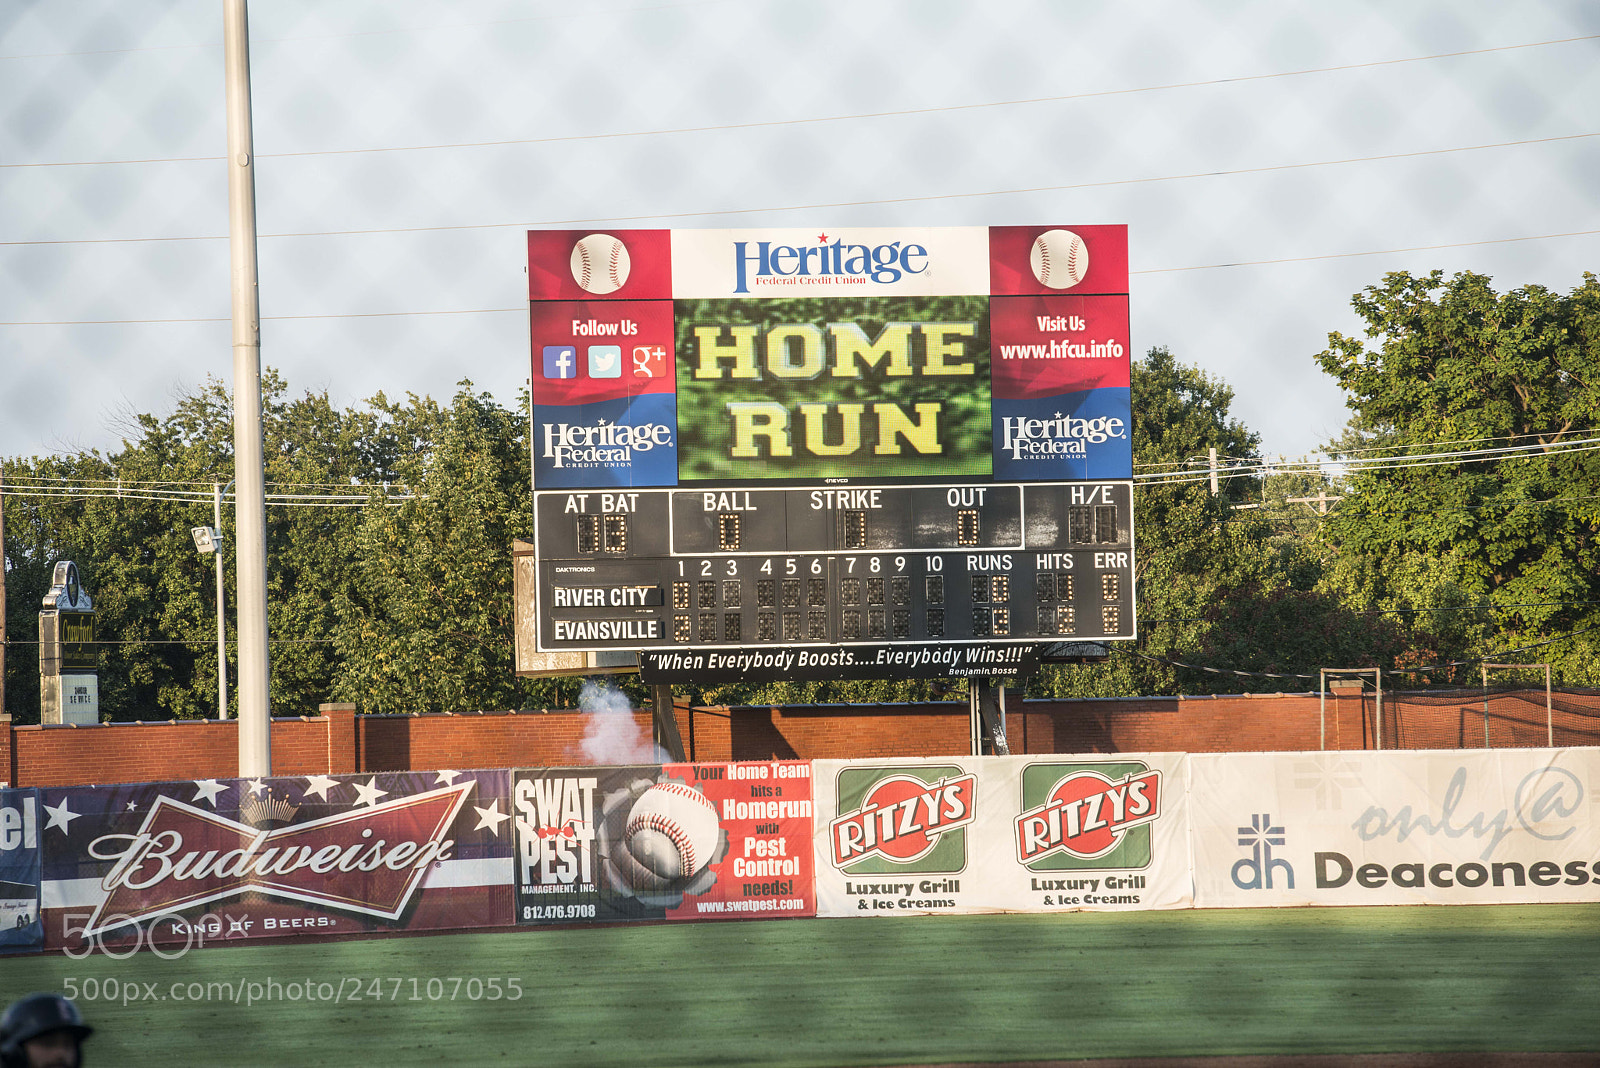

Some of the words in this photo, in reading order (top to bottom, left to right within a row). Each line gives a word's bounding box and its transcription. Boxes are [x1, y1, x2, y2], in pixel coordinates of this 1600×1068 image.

[733, 238, 929, 293] Heritage
[756, 276, 797, 285] Federal
[799, 276, 832, 285] Credit
[835, 275, 867, 284] Union
[572, 320, 619, 336] Follow
[621, 320, 638, 336] Us
[1037, 316, 1066, 332] Visit
[1069, 316, 1085, 331] Us
[693, 322, 977, 380] HOME
[1000, 339, 1123, 359] www.hfcu.info
[542, 421, 672, 458] Heritage
[728, 402, 943, 457] RUN
[1002, 413, 1125, 450] Heritage
[553, 445, 631, 468] Federal
[1012, 438, 1086, 460] Federal
[565, 494, 588, 513] AT
[601, 493, 639, 513] BAT
[703, 491, 757, 511] BALL
[810, 489, 883, 510] STRIKE
[946, 487, 987, 507] OUT
[1070, 485, 1114, 505] H/E
[678, 560, 684, 577] 1
[700, 560, 712, 576] 2
[726, 559, 738, 576] 3
[760, 559, 772, 575] 4
[785, 558, 797, 575] 5
[810, 558, 822, 574] 6
[845, 557, 856, 573] 7
[869, 556, 881, 573] 8
[894, 556, 906, 572] 9
[925, 555, 943, 572] 10
[967, 554, 1013, 571] RUNS
[1036, 553, 1074, 570] HITS
[1094, 552, 1128, 569] ERR
[555, 588, 605, 607] RIVER
[610, 588, 648, 607] CITY
[62, 615, 94, 651] Crawford
[555, 620, 657, 640] EVANSVILLE
[708, 650, 795, 672] Everybody
[948, 667, 988, 676] Benjamin
[992, 667, 1018, 675] Bosse
[693, 765, 724, 780] Your
[727, 764, 768, 780] Home
[771, 763, 810, 779] Team
[751, 784, 773, 797] hits
[775, 786, 782, 797] a
[515, 777, 597, 832] SWAT
[723, 798, 812, 820] Homerun
[1024, 773, 1151, 856] RITZY'S
[840, 777, 965, 859] RITZY'S
[756, 823, 779, 835] with
[519, 828, 594, 885] PEST
[744, 837, 787, 857] Pest
[87, 828, 454, 891] Budweiser
[733, 856, 800, 877] Control
[580, 884, 598, 893] INC.
[743, 880, 793, 896] needs!
[846, 880, 915, 896] Luxury
[919, 879, 961, 894] Grill
[1030, 876, 1100, 892] Luxury
[1105, 875, 1146, 890] Grill
[697, 898, 804, 913] www.swatpest.com
[857, 899, 869, 910] &
[872, 898, 895, 910] Ice
[898, 897, 956, 909] Creams
[1043, 895, 1055, 906] &
[1058, 894, 1081, 906] Ice
[1083, 893, 1141, 905] Creams
[523, 904, 595, 920] 812.476.9708
[172, 922, 220, 935] KING
[230, 920, 253, 932] OF
